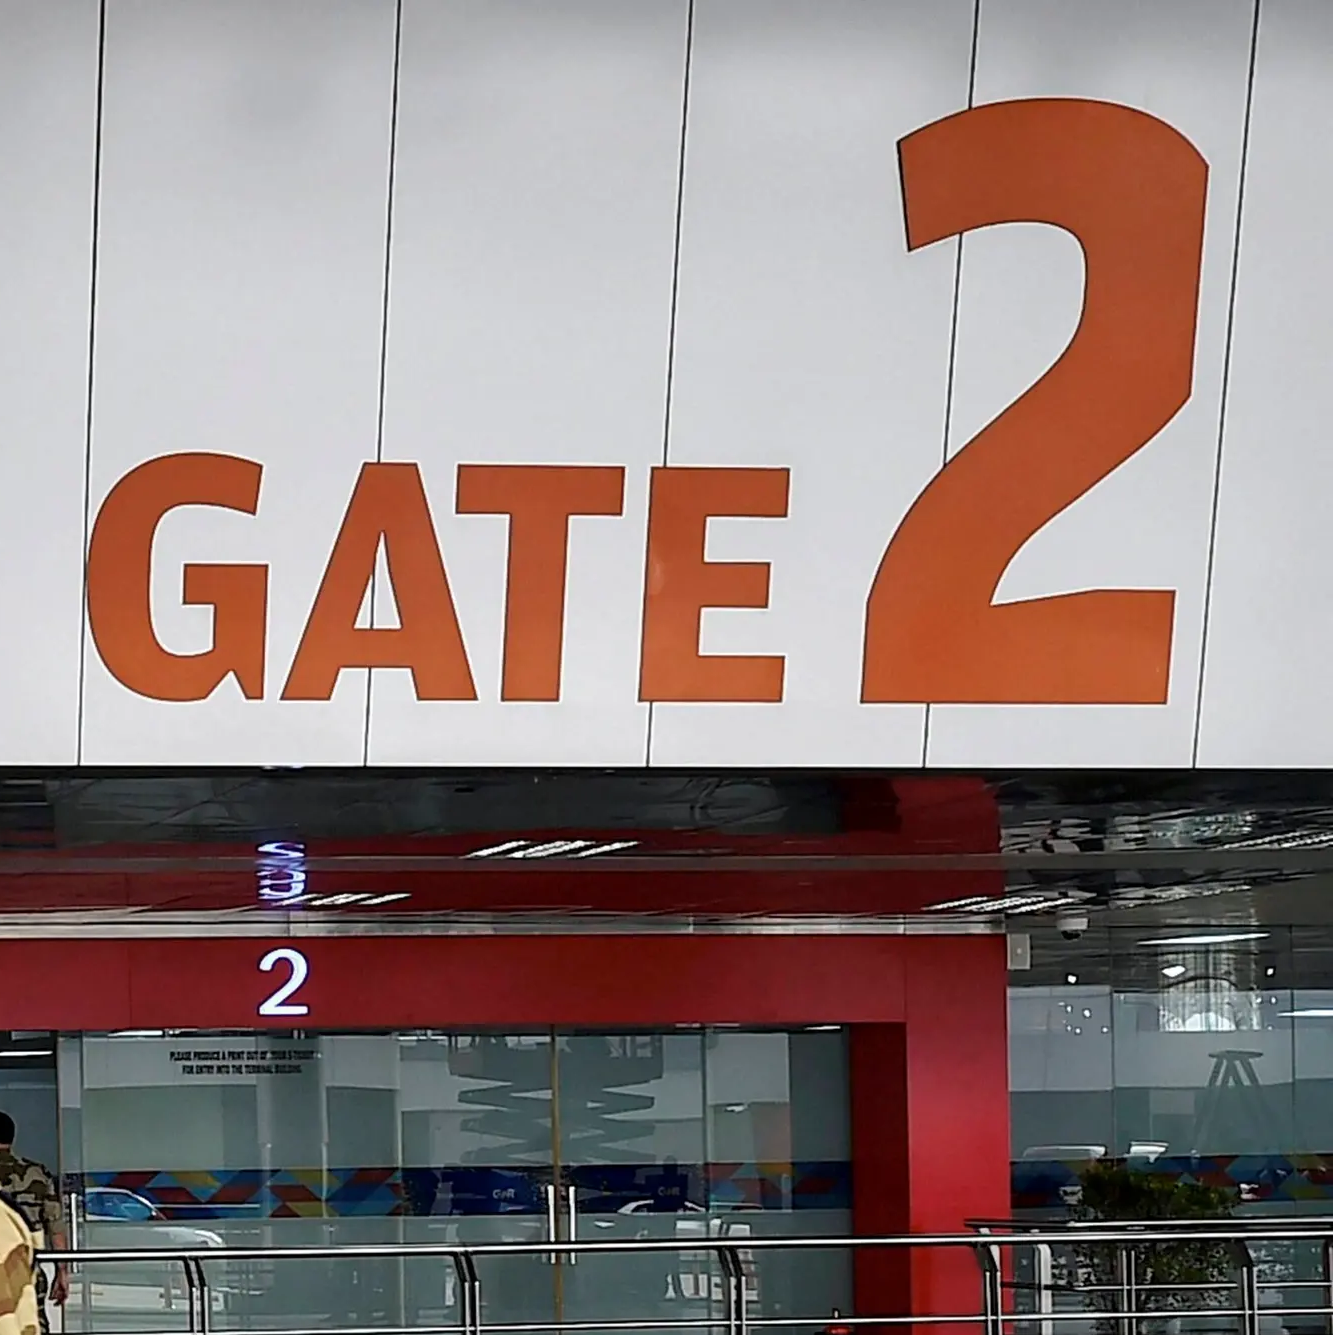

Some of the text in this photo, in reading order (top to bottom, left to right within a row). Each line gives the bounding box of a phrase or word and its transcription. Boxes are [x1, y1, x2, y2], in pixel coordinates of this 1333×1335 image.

[86, 98, 1209, 704] GATE 2
[259, 948, 309, 1016] 2
[169, 1050, 192, 1061] PLEASE
